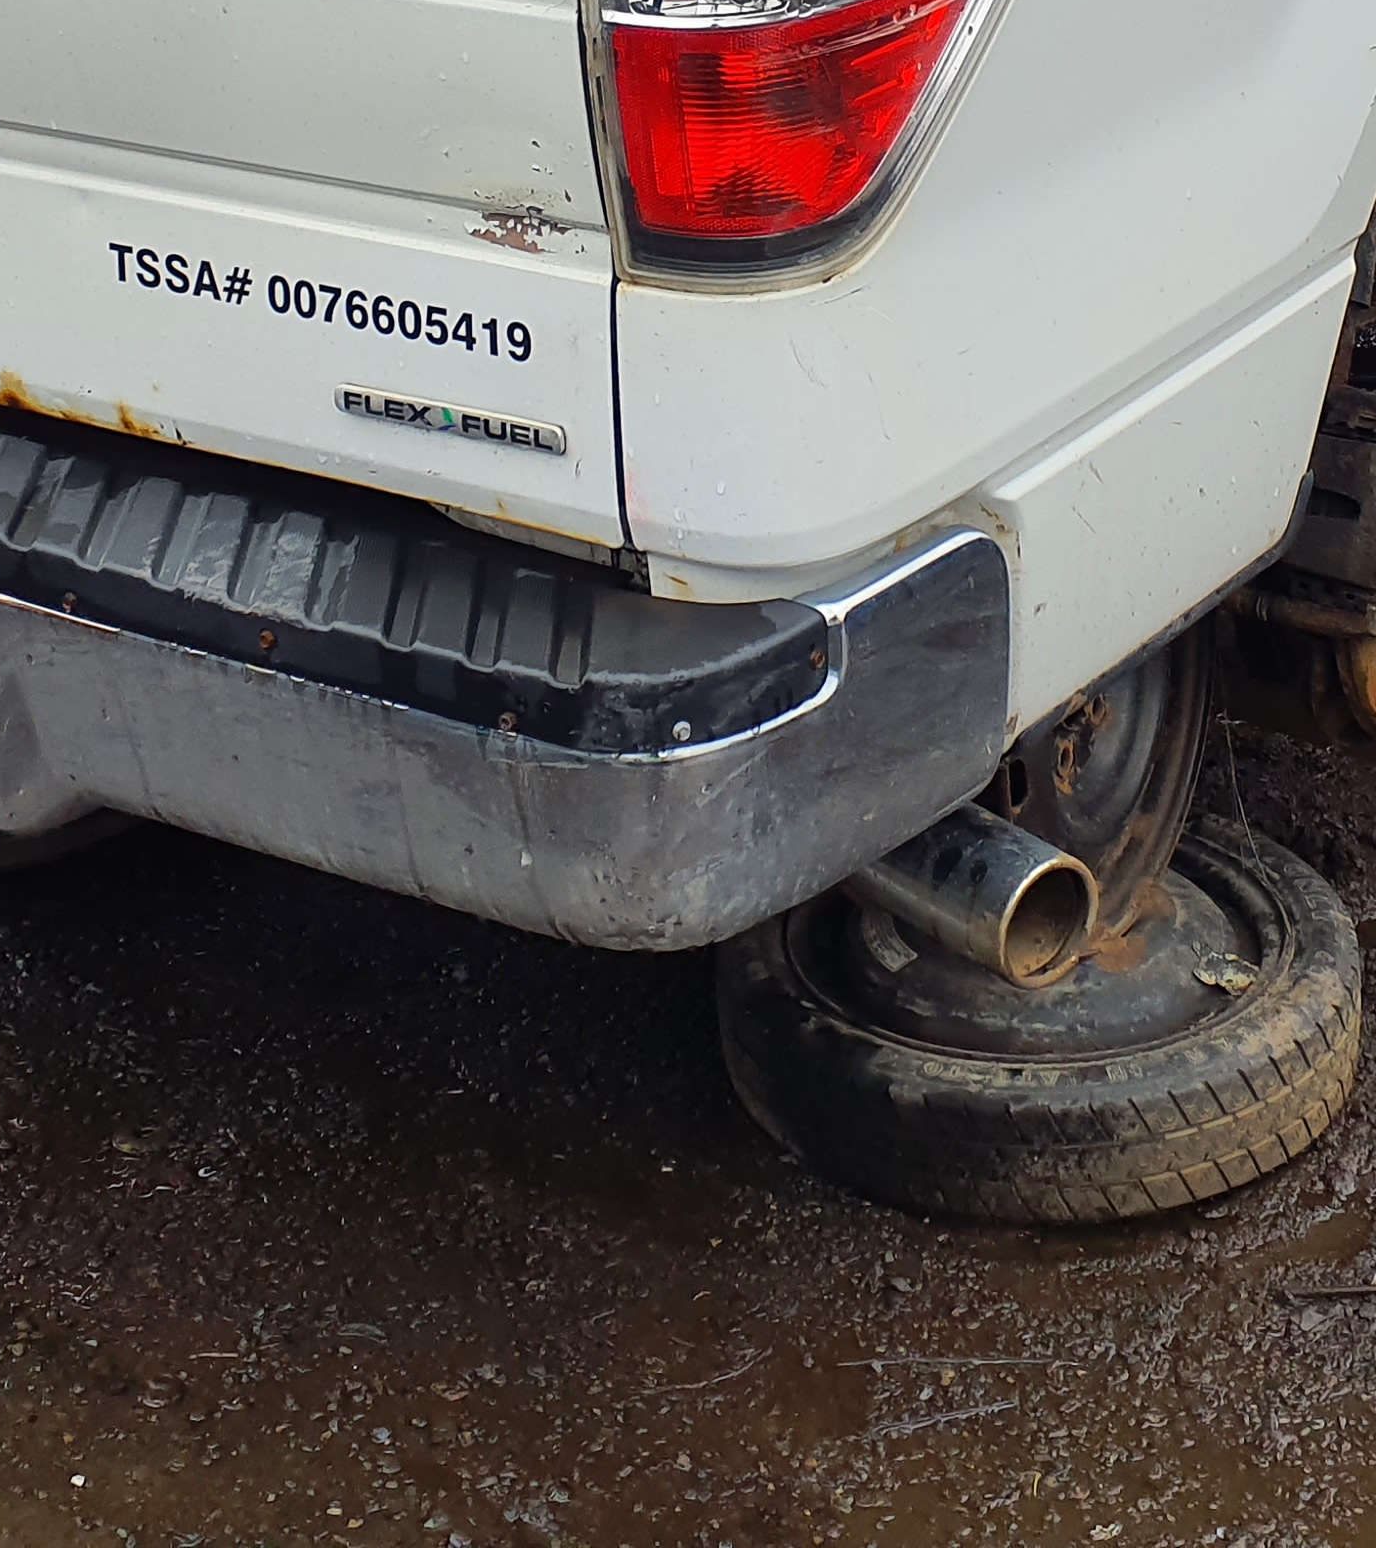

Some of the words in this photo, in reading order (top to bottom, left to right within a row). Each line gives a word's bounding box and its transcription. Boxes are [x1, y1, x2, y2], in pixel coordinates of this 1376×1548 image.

[108, 242, 254, 306] TSSA#
[267, 274, 533, 363] 0076605419
[342, 390, 434, 428] FLEX
[461, 411, 555, 451] FUEL
